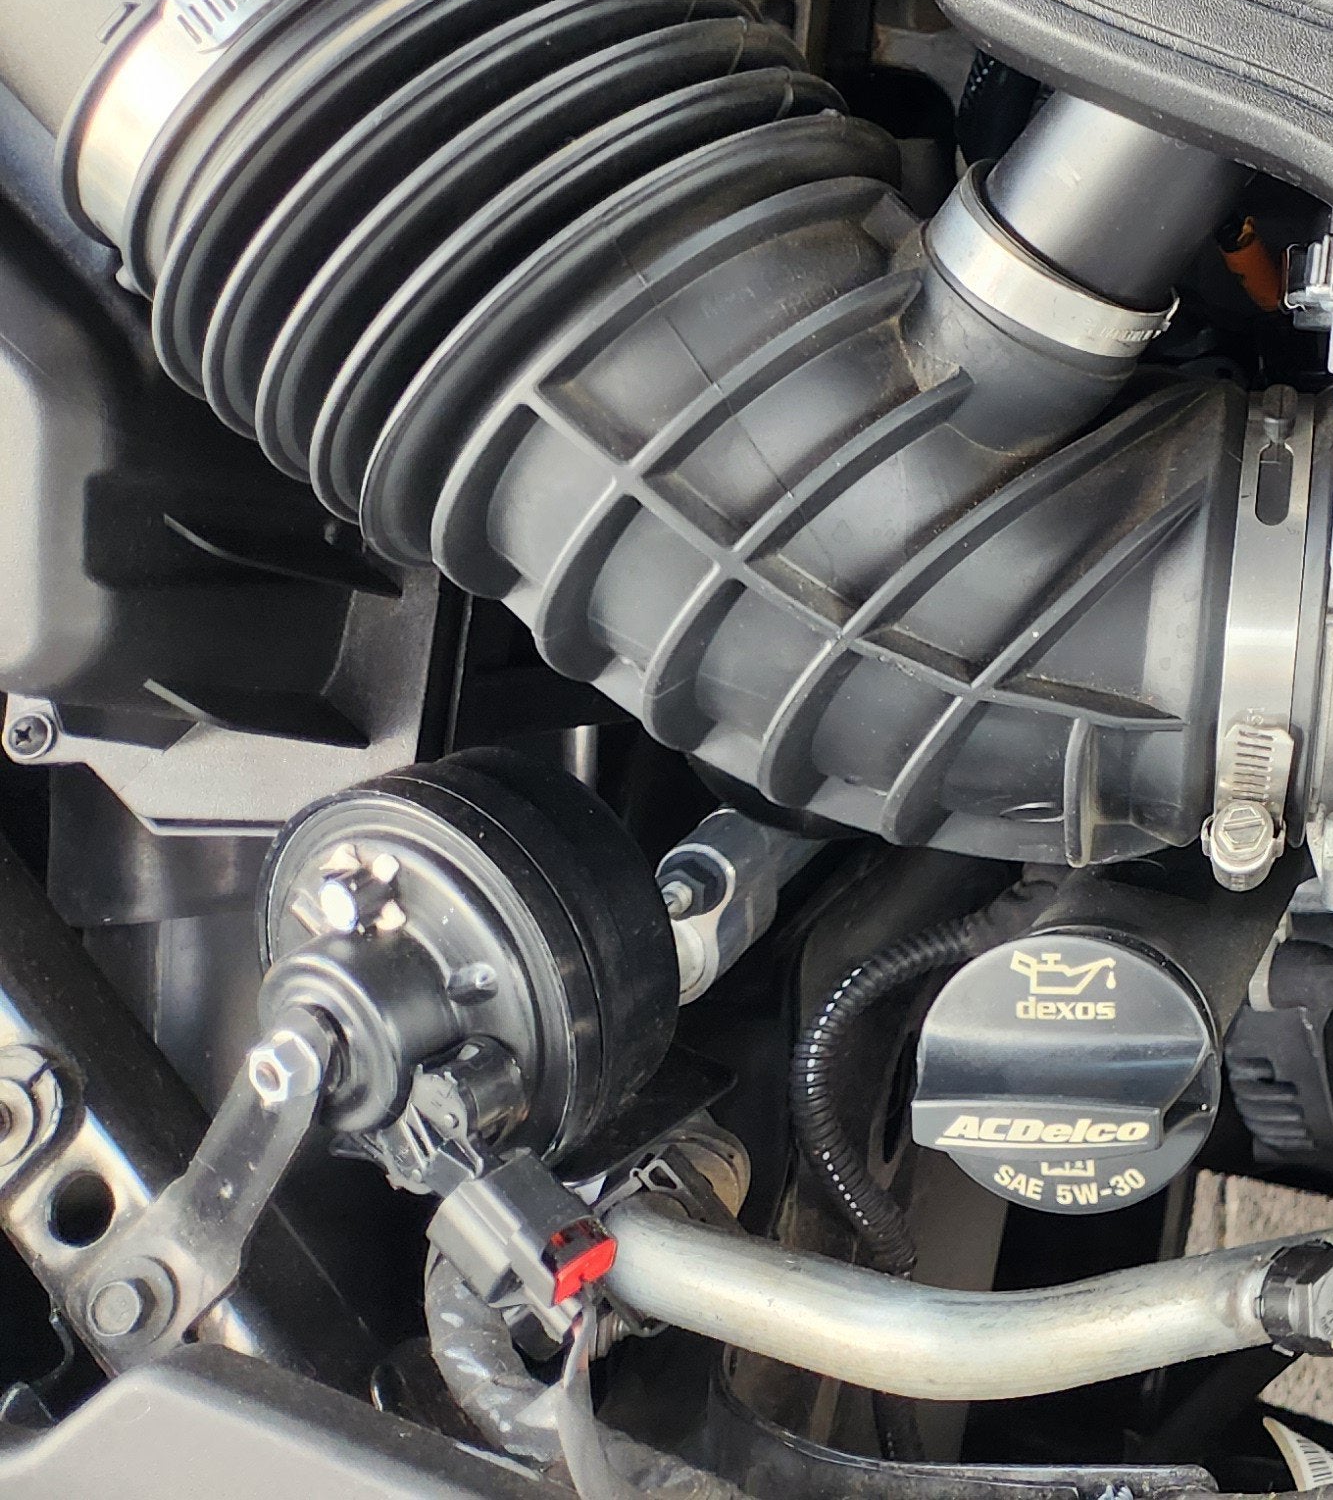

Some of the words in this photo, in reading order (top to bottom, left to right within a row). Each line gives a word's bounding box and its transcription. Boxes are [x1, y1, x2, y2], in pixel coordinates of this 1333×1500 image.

[1015, 996, 1116, 1021] dexos
[943, 1115, 1151, 1143] ACDelco
[993, 1165, 1044, 1201] SAE
[1056, 1168, 1146, 1206] 5W-30
